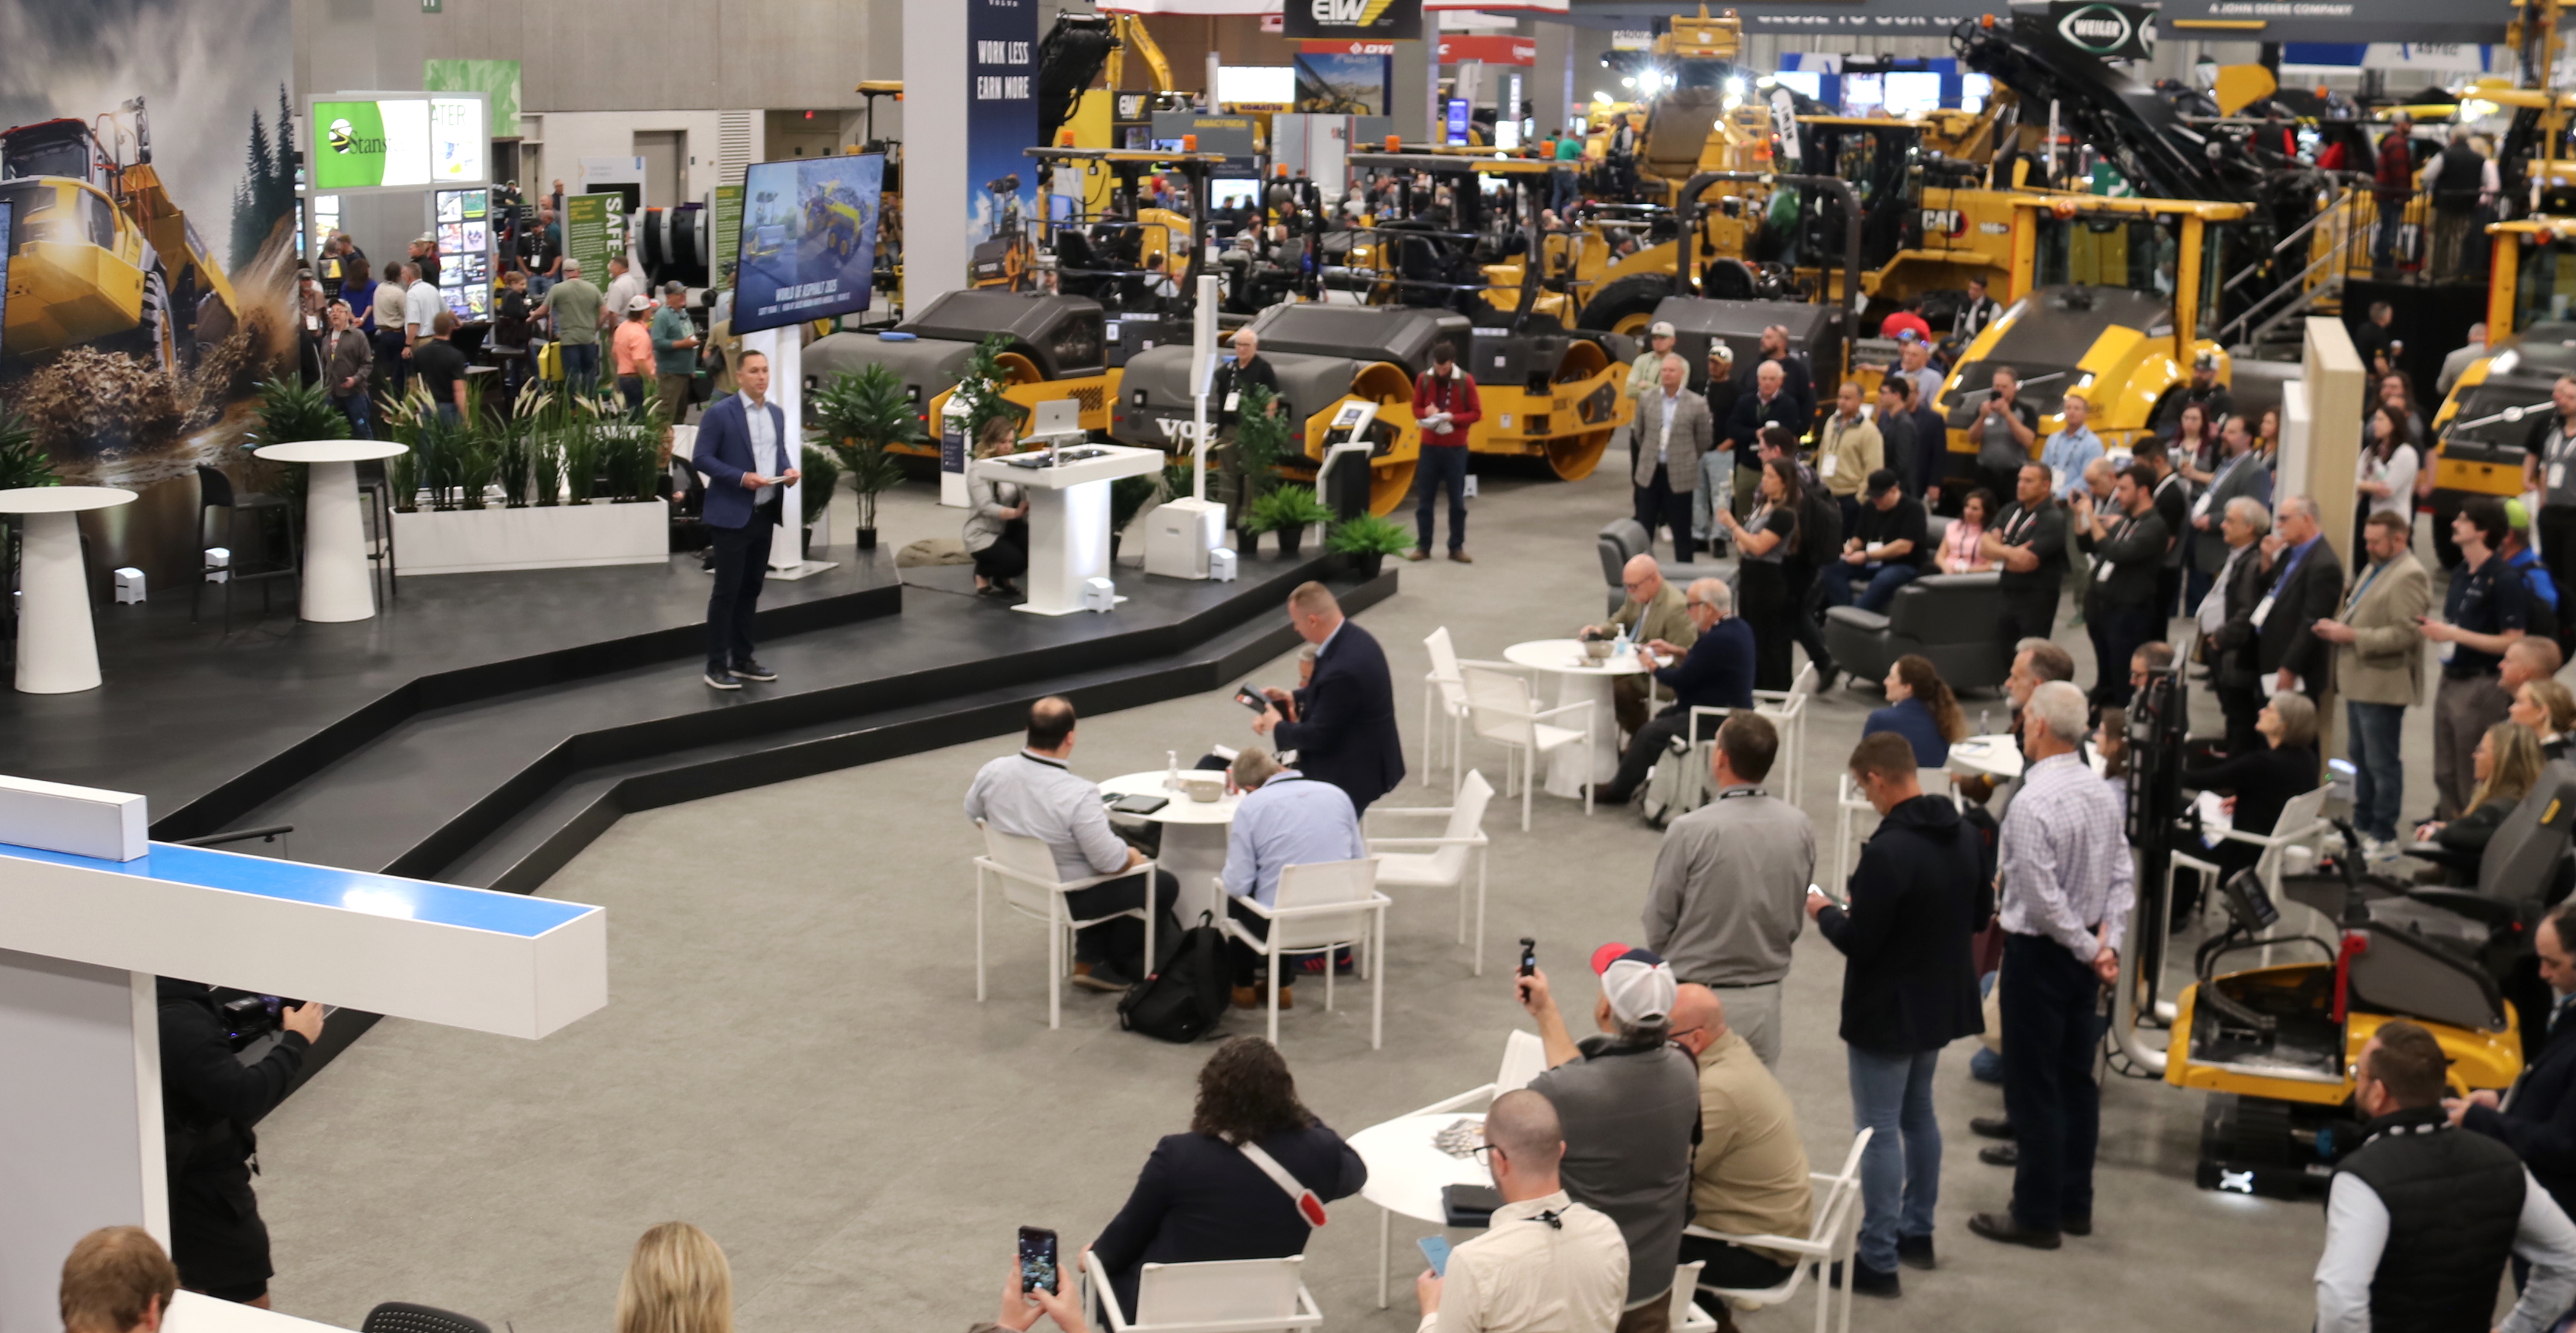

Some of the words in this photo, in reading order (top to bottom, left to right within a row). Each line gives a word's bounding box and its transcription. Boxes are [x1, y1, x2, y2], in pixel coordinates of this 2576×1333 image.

[2220, 3, 2254, 15] JOHN
[2254, 3, 2291, 15] DEERE
[2293, 4, 2354, 16] COMPANY
[2074, 19, 2121, 37] WEILER
[978, 39, 1005, 64] WORK
[1008, 41, 1029, 64] LESS
[977, 76, 1002, 100] EARN
[1005, 76, 1030, 99] MORE
